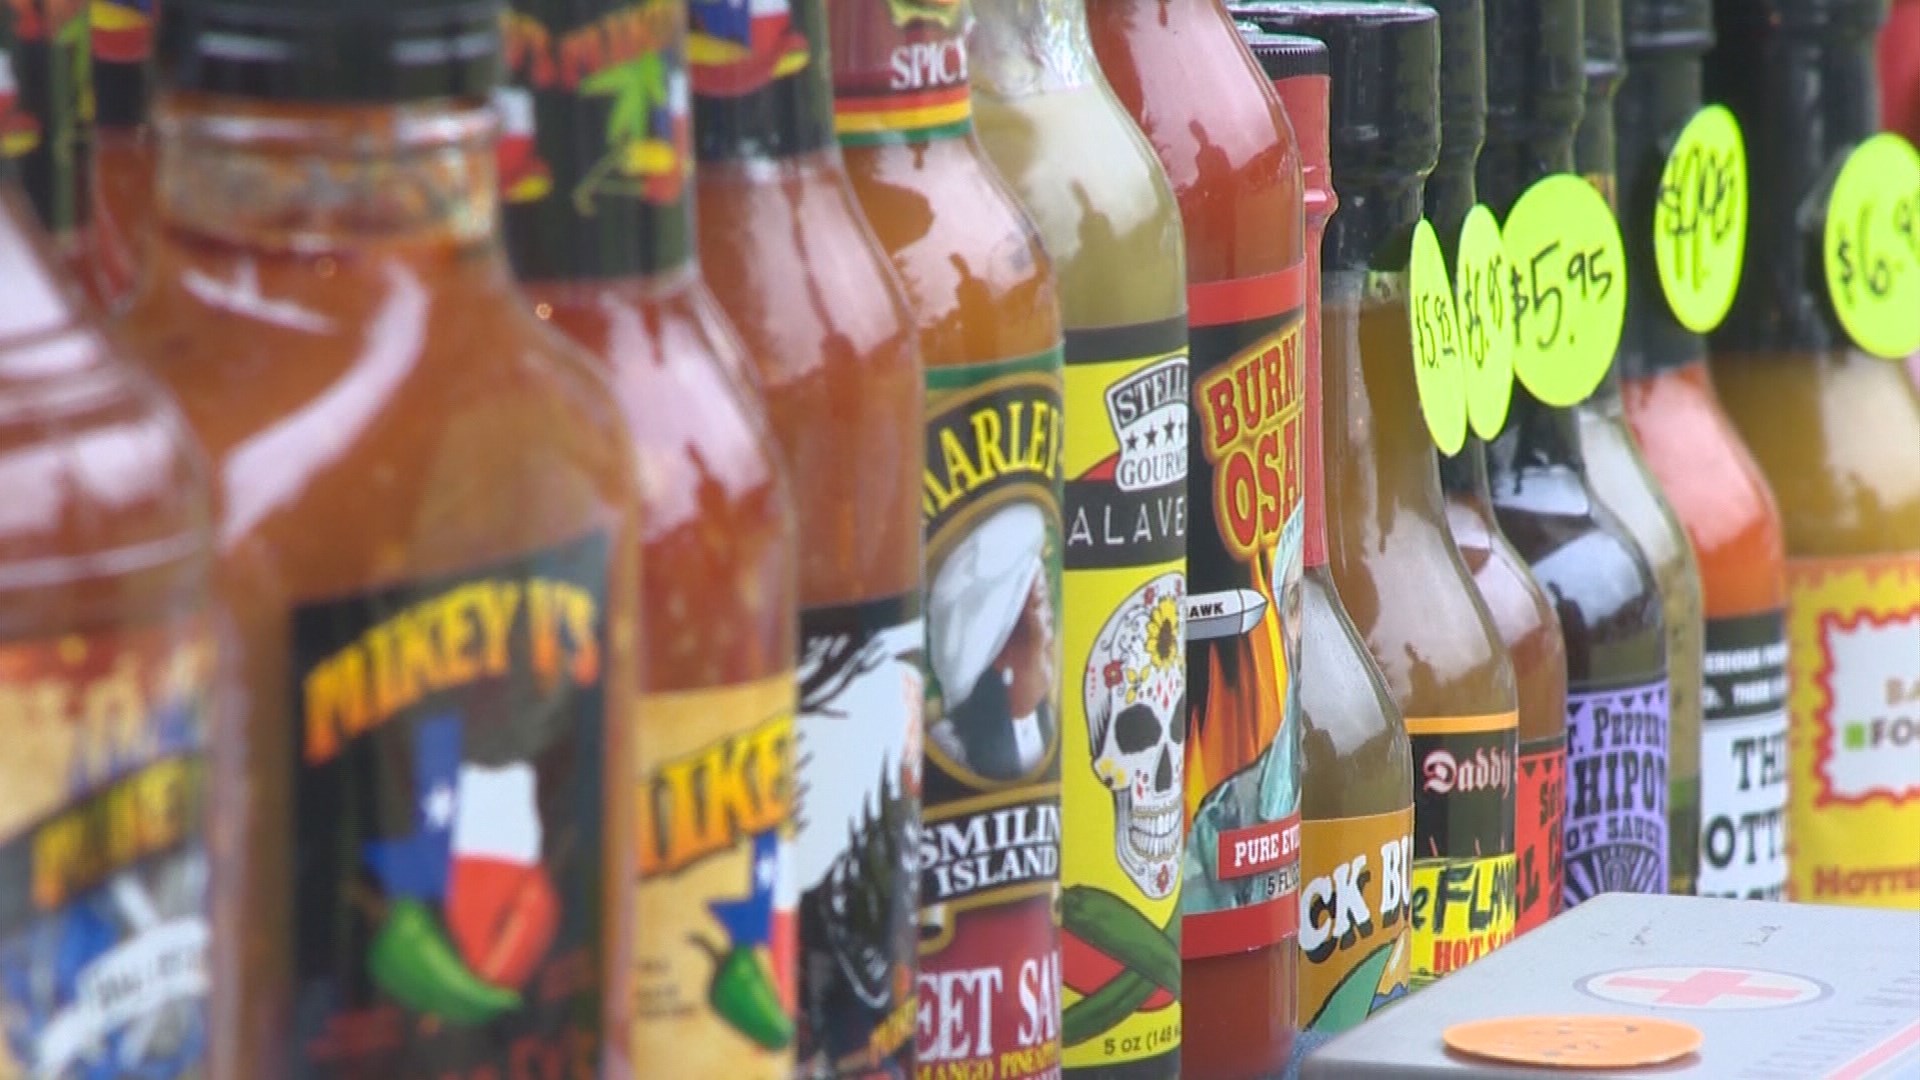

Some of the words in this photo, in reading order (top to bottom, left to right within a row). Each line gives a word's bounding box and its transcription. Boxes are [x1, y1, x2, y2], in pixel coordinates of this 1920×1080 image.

[1510, 240, 1613, 352] $5.95
[1067, 496, 1185, 546] ALAVE
[1186, 602, 1225, 619] AWK
[1423, 747, 1511, 799] Daddy
[935, 846, 1059, 897] ISLAND
[1234, 833, 1279, 867] PURE
[1299, 854, 1373, 957] CK
[1104, 1038, 1116, 1055] 5
